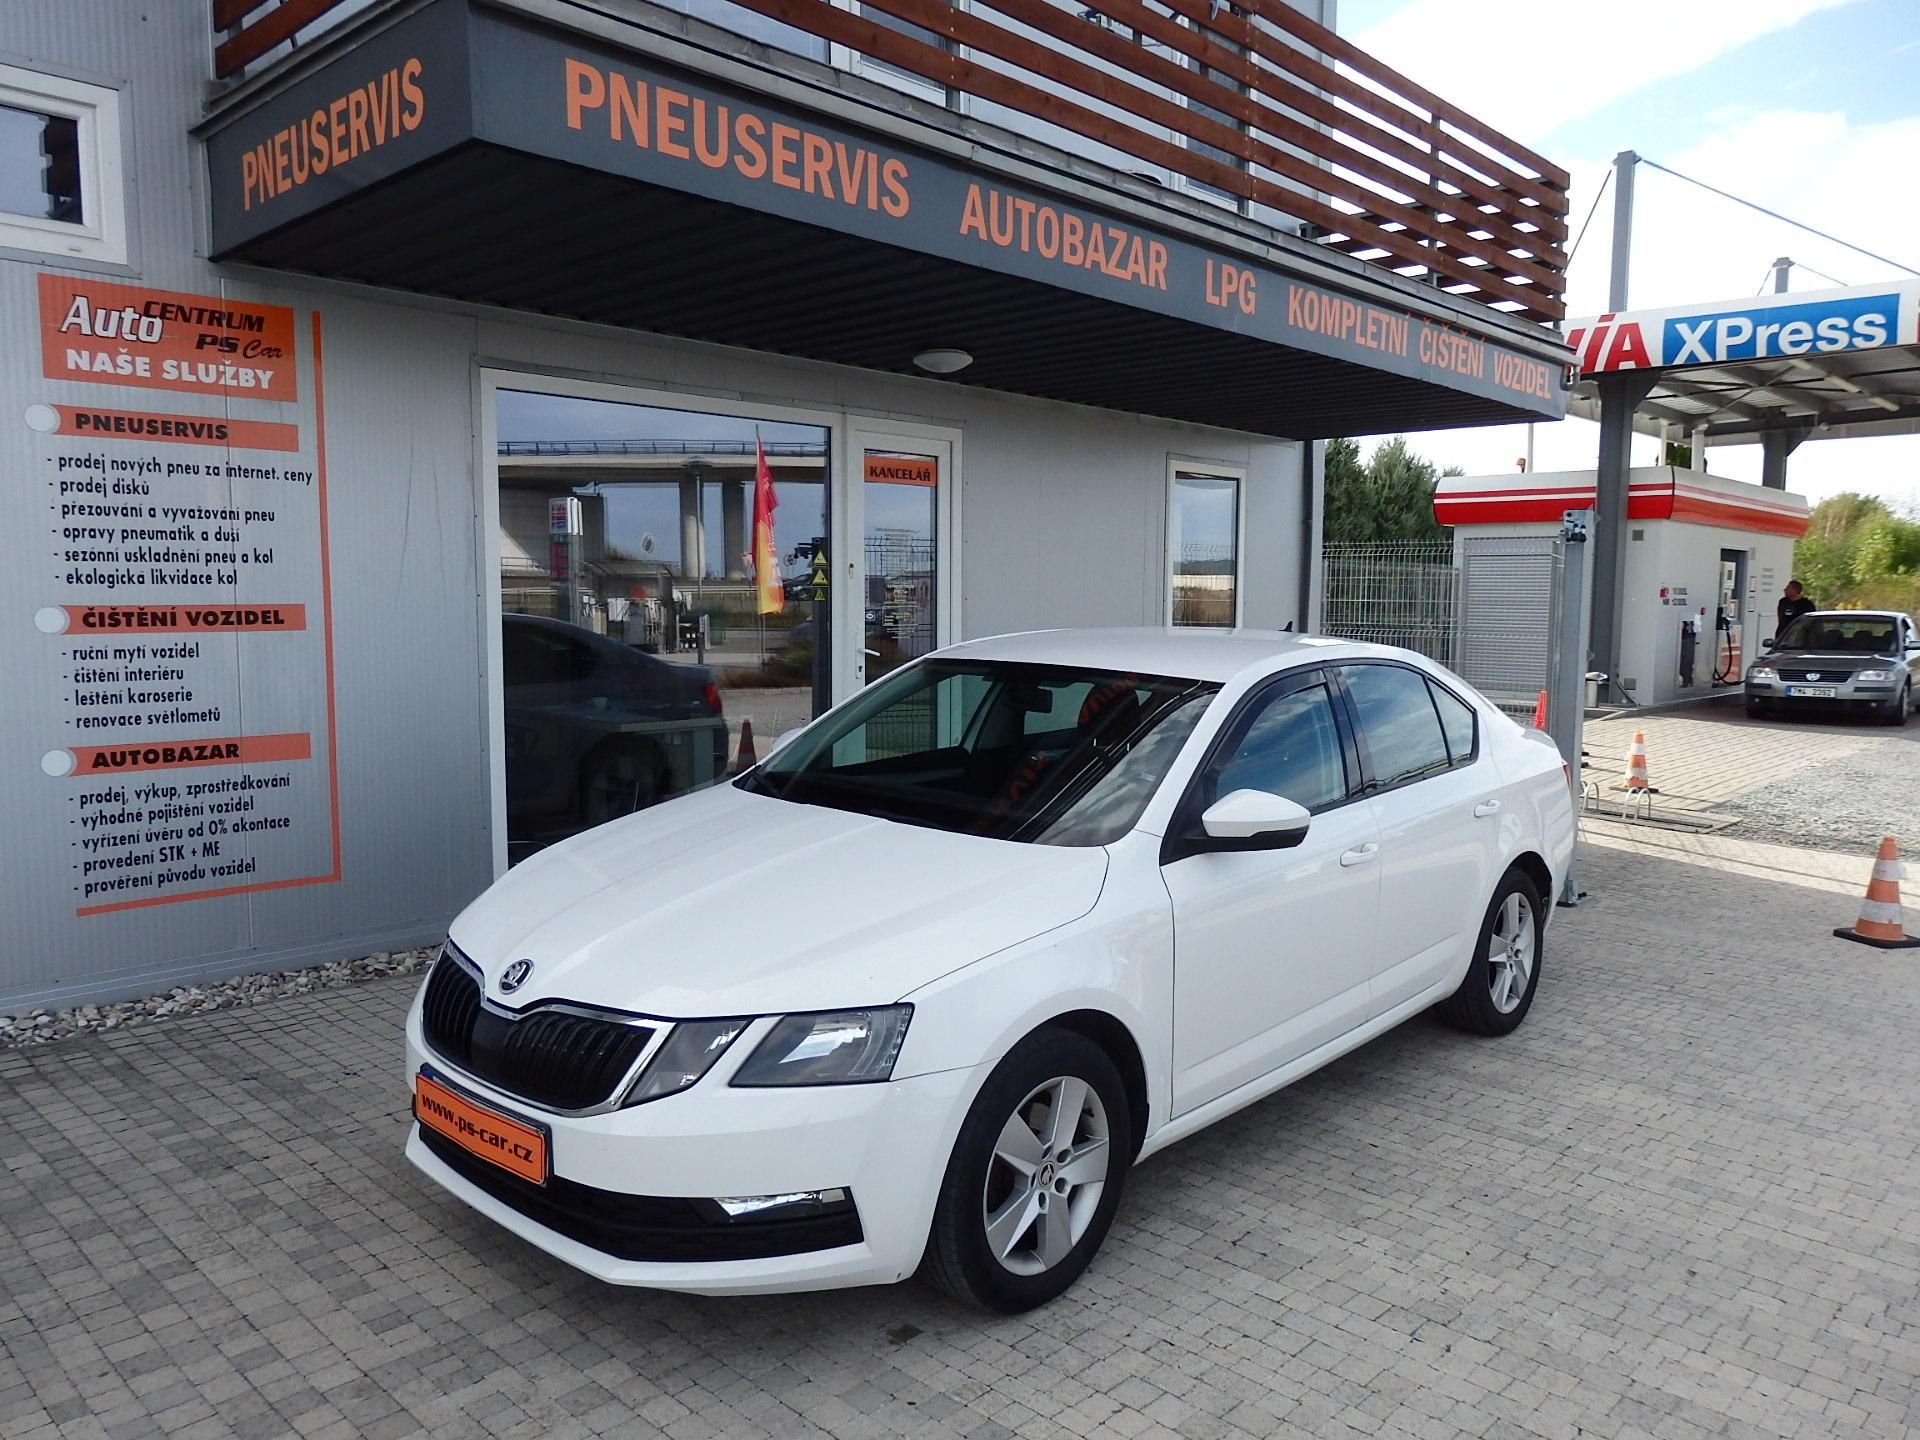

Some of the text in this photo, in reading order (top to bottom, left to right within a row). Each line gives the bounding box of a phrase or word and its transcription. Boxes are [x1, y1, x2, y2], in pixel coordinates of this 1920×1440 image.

[242, 57, 424, 211] PNEUSERVIS
[565, 57, 1551, 399] PNEUSERVIS AUTOBAZAR LPG KOMPLETNÍ ČIŠTĚNÍ VOZIDEL
[58, 294, 265, 344] Auto CENTRUM
[195, 334, 283, 359] PS Car
[1671, 313, 1888, 365] XPress
[66, 347, 274, 389] NAŠE SLUŽBY
[75, 413, 228, 439] PNEUSERVIS
[58, 455, 106, 473] prodej
[111, 458, 162, 477] nových
[167, 463, 200, 478] pneu
[204, 464, 220, 477] za
[283, 469, 313, 485] ceny
[869, 465, 931, 482] KANCELÁŘ
[60, 479, 150, 498] prodej disků
[61, 501, 275, 523] přezouvání a vyvažování pneu
[63, 526, 240, 544] opravy pneumatik a duší
[64, 547, 273, 564] sezónní uskladnění pneu a kol
[66, 568, 238, 588] ekologická likvidace kol
[82, 606, 284, 628] ČIŠTĚNÍ VOZIDEL
[72, 642, 200, 660] ruční mytí vozidel
[74, 667, 184, 683] čištění interiéru
[75, 688, 193, 705] leštění karoserie
[76, 706, 221, 728] renovace světlometů
[92, 744, 240, 768] AUTOBAZAR
[80, 775, 290, 809] prodej, výkup, zprostředkování
[81, 797, 254, 829] výhodné pojištění vozidel
[82, 816, 290, 851] vyřízení úvěru od 0% akontace
[84, 840, 220, 875] provedení STK + ME
[84, 857, 256, 898] prověření původu vozidel
[421, 1094, 533, 1163] www.ps-car.cz
